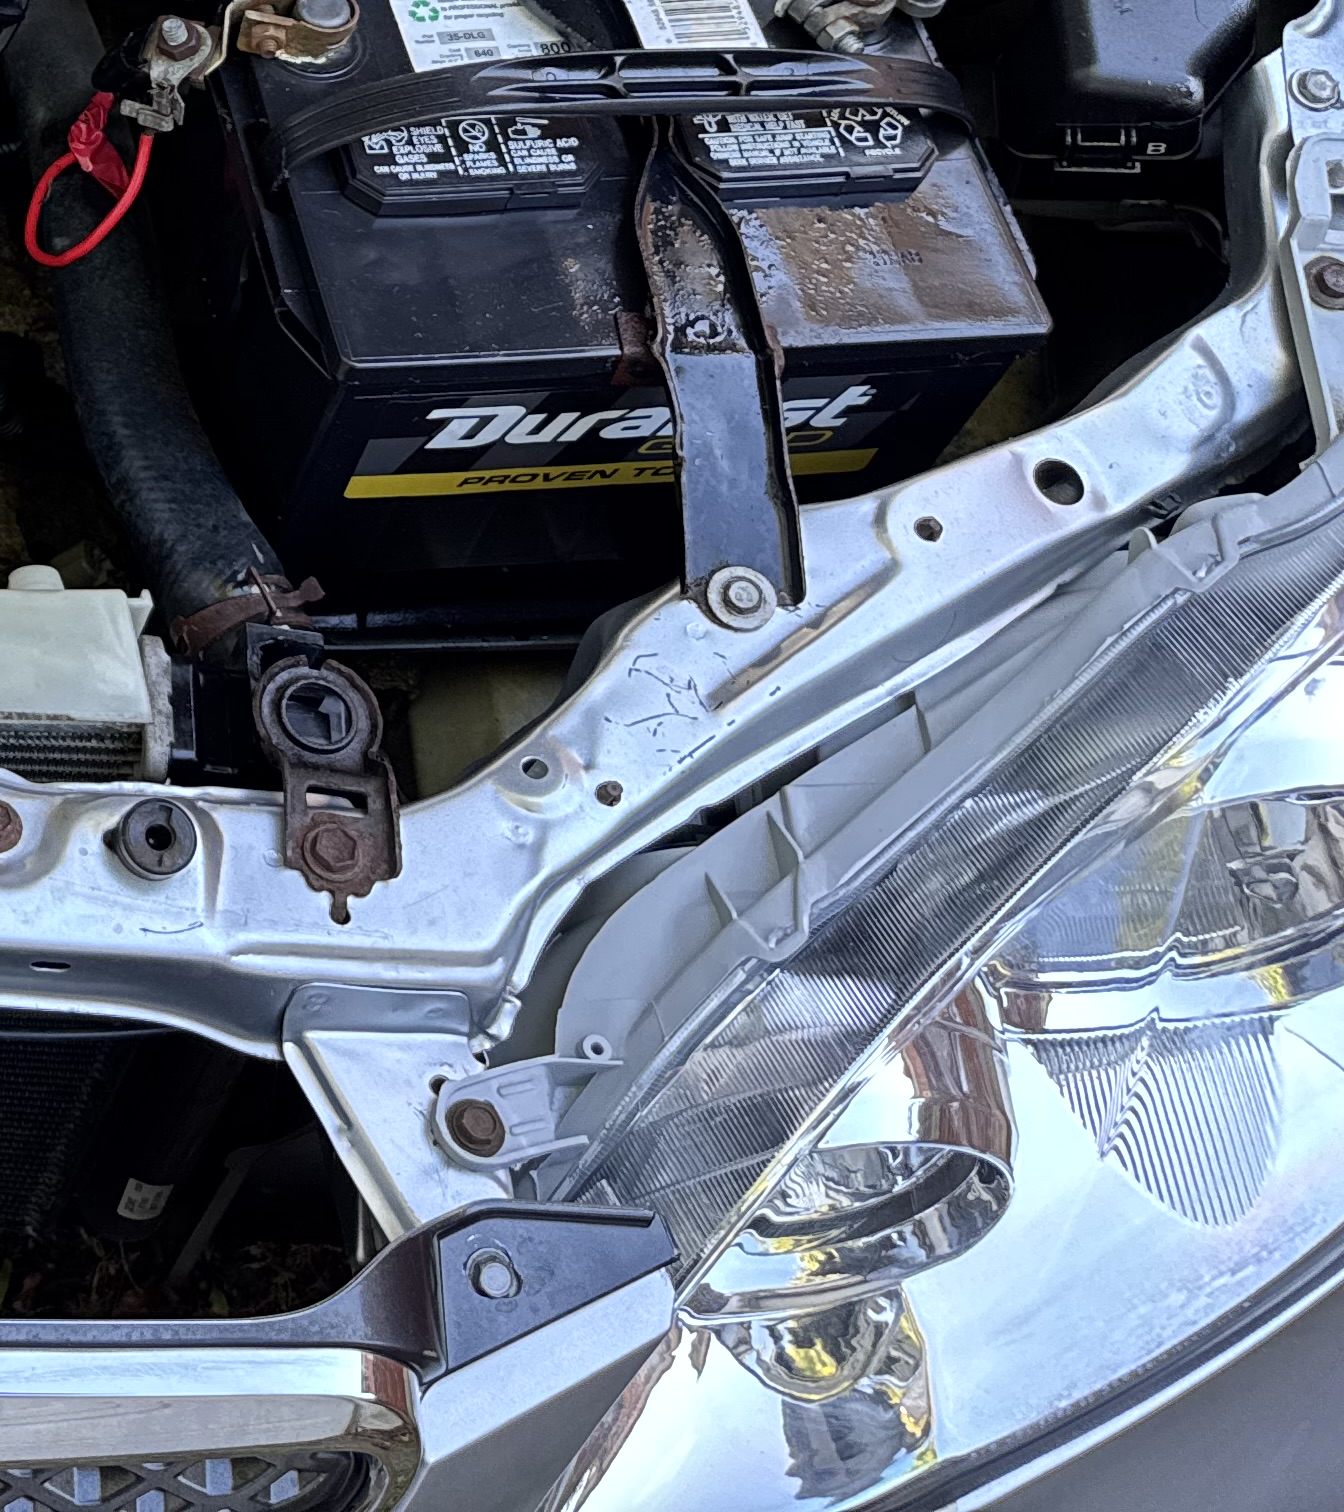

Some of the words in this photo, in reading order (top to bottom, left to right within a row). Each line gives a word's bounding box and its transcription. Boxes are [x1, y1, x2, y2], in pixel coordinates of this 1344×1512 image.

[540, 41, 572, 55] 800
[409, 125, 444, 135] SHIELD
[412, 135, 438, 144] EYES
[507, 139, 554, 149] SULFURIC
[556, 137, 579, 148] ACID
[392, 143, 445, 154] EXPLOSIVE
[468, 143, 486, 152] NO
[511, 149, 529, 157] CAN
[530, 148, 558, 156] CAUSE
[1146, 142, 1167, 154] B
[395, 153, 428, 163] GASES
[462, 152, 497, 160] SPARKS
[513, 155, 560, 164] BLINDNESS
[561, 154, 575, 162] OR
[465, 159, 499, 168] FLAMES
[424, 384, 878, 450] Durast
[457, 467, 621, 488] PROVEN
